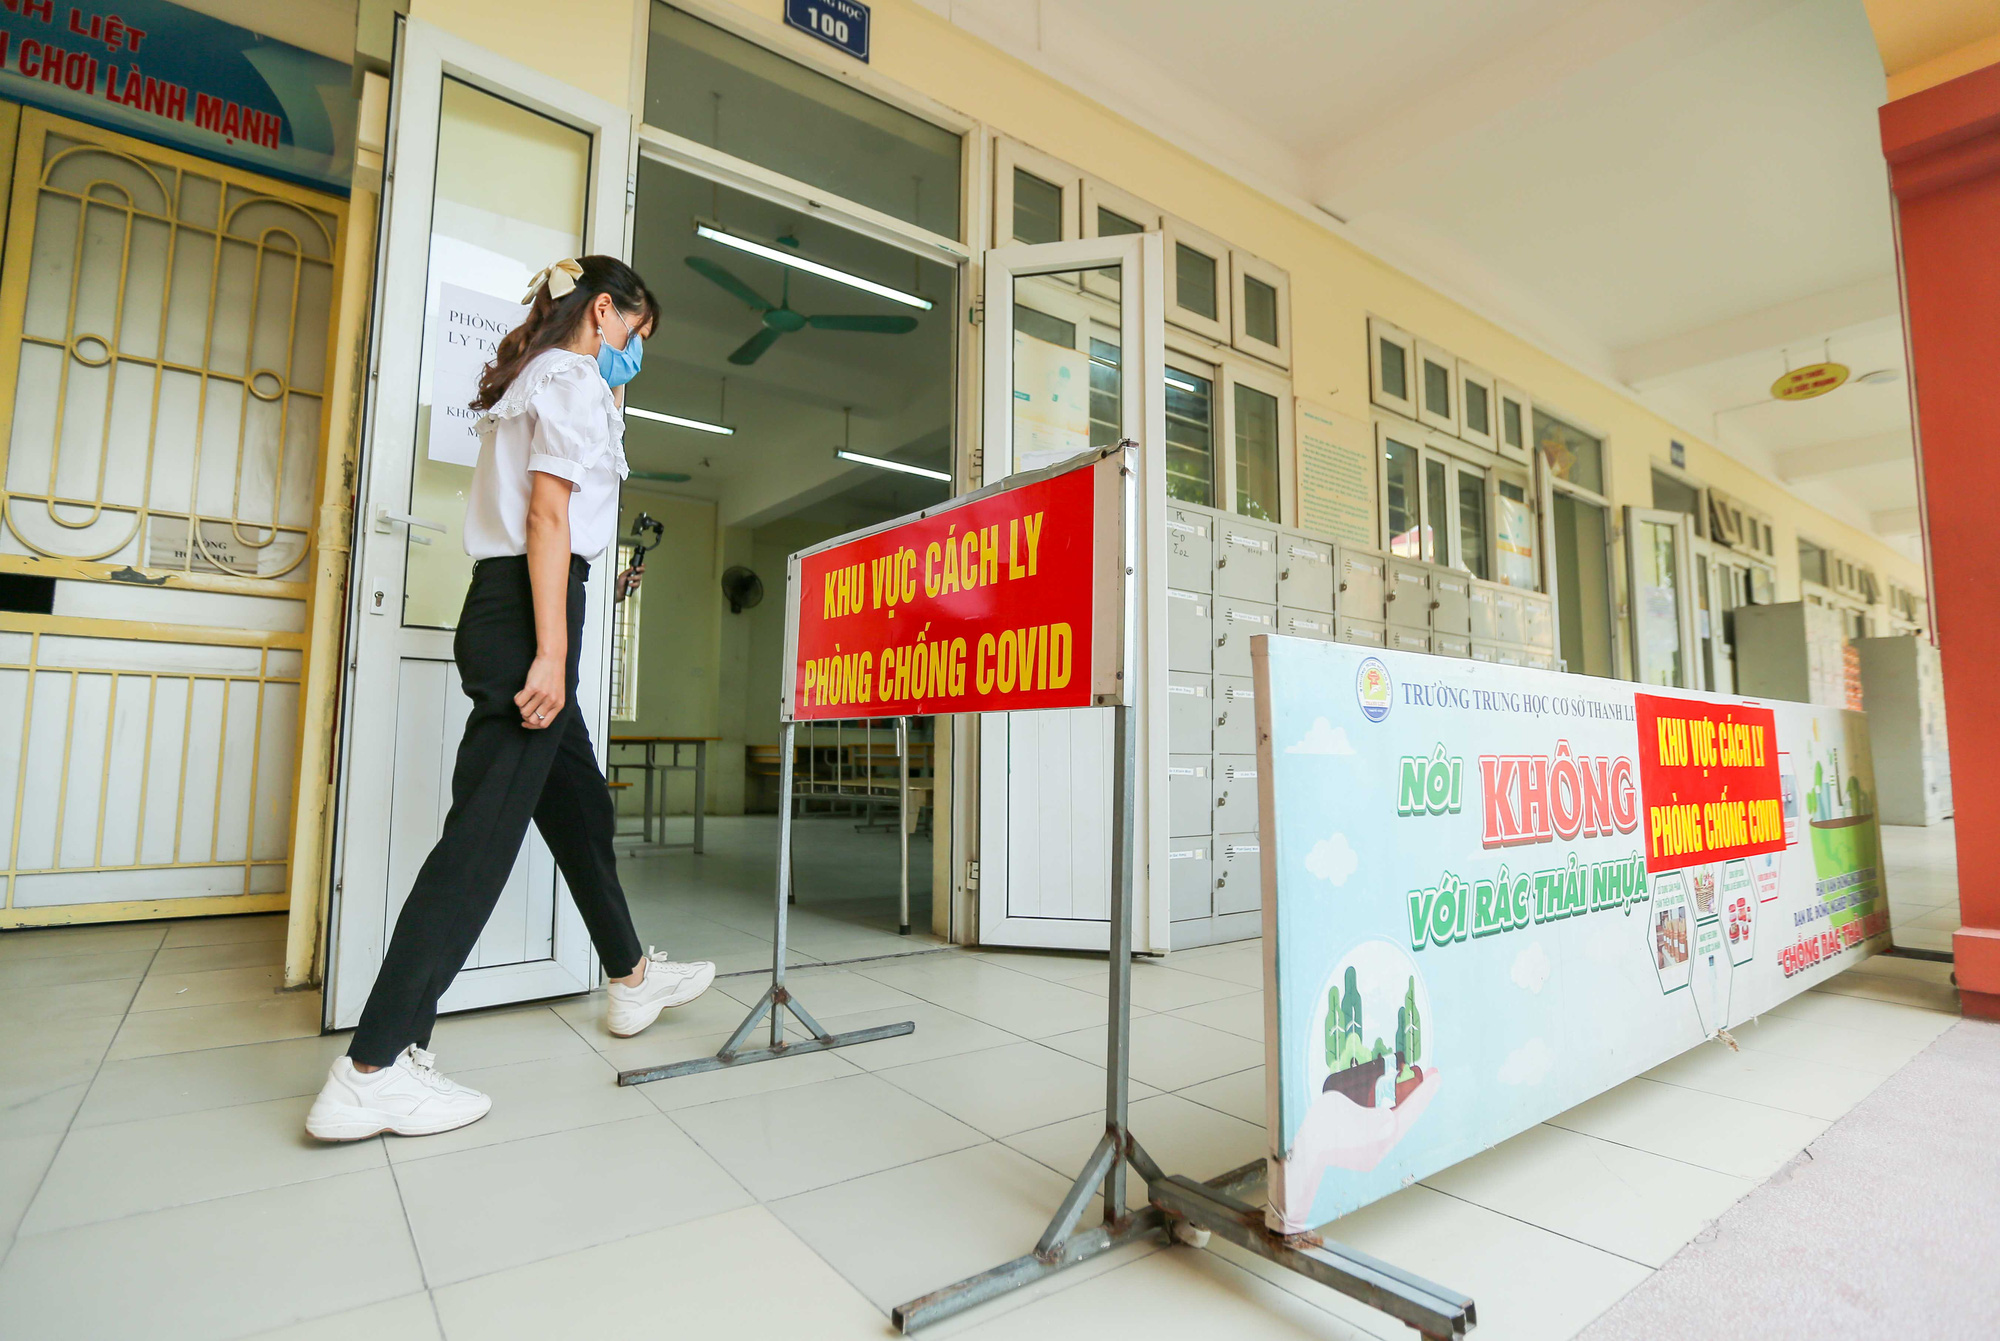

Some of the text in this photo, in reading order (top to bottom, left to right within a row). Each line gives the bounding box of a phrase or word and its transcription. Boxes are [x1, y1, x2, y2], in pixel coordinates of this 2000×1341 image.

[69, 8, 147, 52] LIỆT
[808, 7, 849, 44] 100
[837, 1, 863, 20] HỌC
[18, 38, 98, 96] CHƠI
[105, 64, 188, 122] LÀNH
[194, 92, 282, 151] MẠNH
[448, 331, 498, 356] LY TẠ
[449, 310, 508, 336] PHÒNG
[823, 511, 1044, 620] KHU VỰC CÁCH LY
[803, 622, 1073, 707] PHÒNG CHỐNG COVID
[1401, 680, 1470, 709] TRƯỜNG
[1473, 689, 1520, 712] TRUNG
[1523, 693, 1549, 718] HỌC
[1552, 696, 1569, 715] CƠ
[1571, 695, 1585, 717] SỞ
[1587, 700, 1622, 720] THANH
[1656, 713, 1765, 778] KHU VỰC CÁCH LY
[1398, 738, 1638, 850] NÓI KHÔNG
[1650, 785, 1781, 858] PHÒNG CHỐNG COVID
[1407, 850, 1650, 951] VỚI RÁC THẢI NHỰA
[1821, 925, 1842, 961] RÁC
